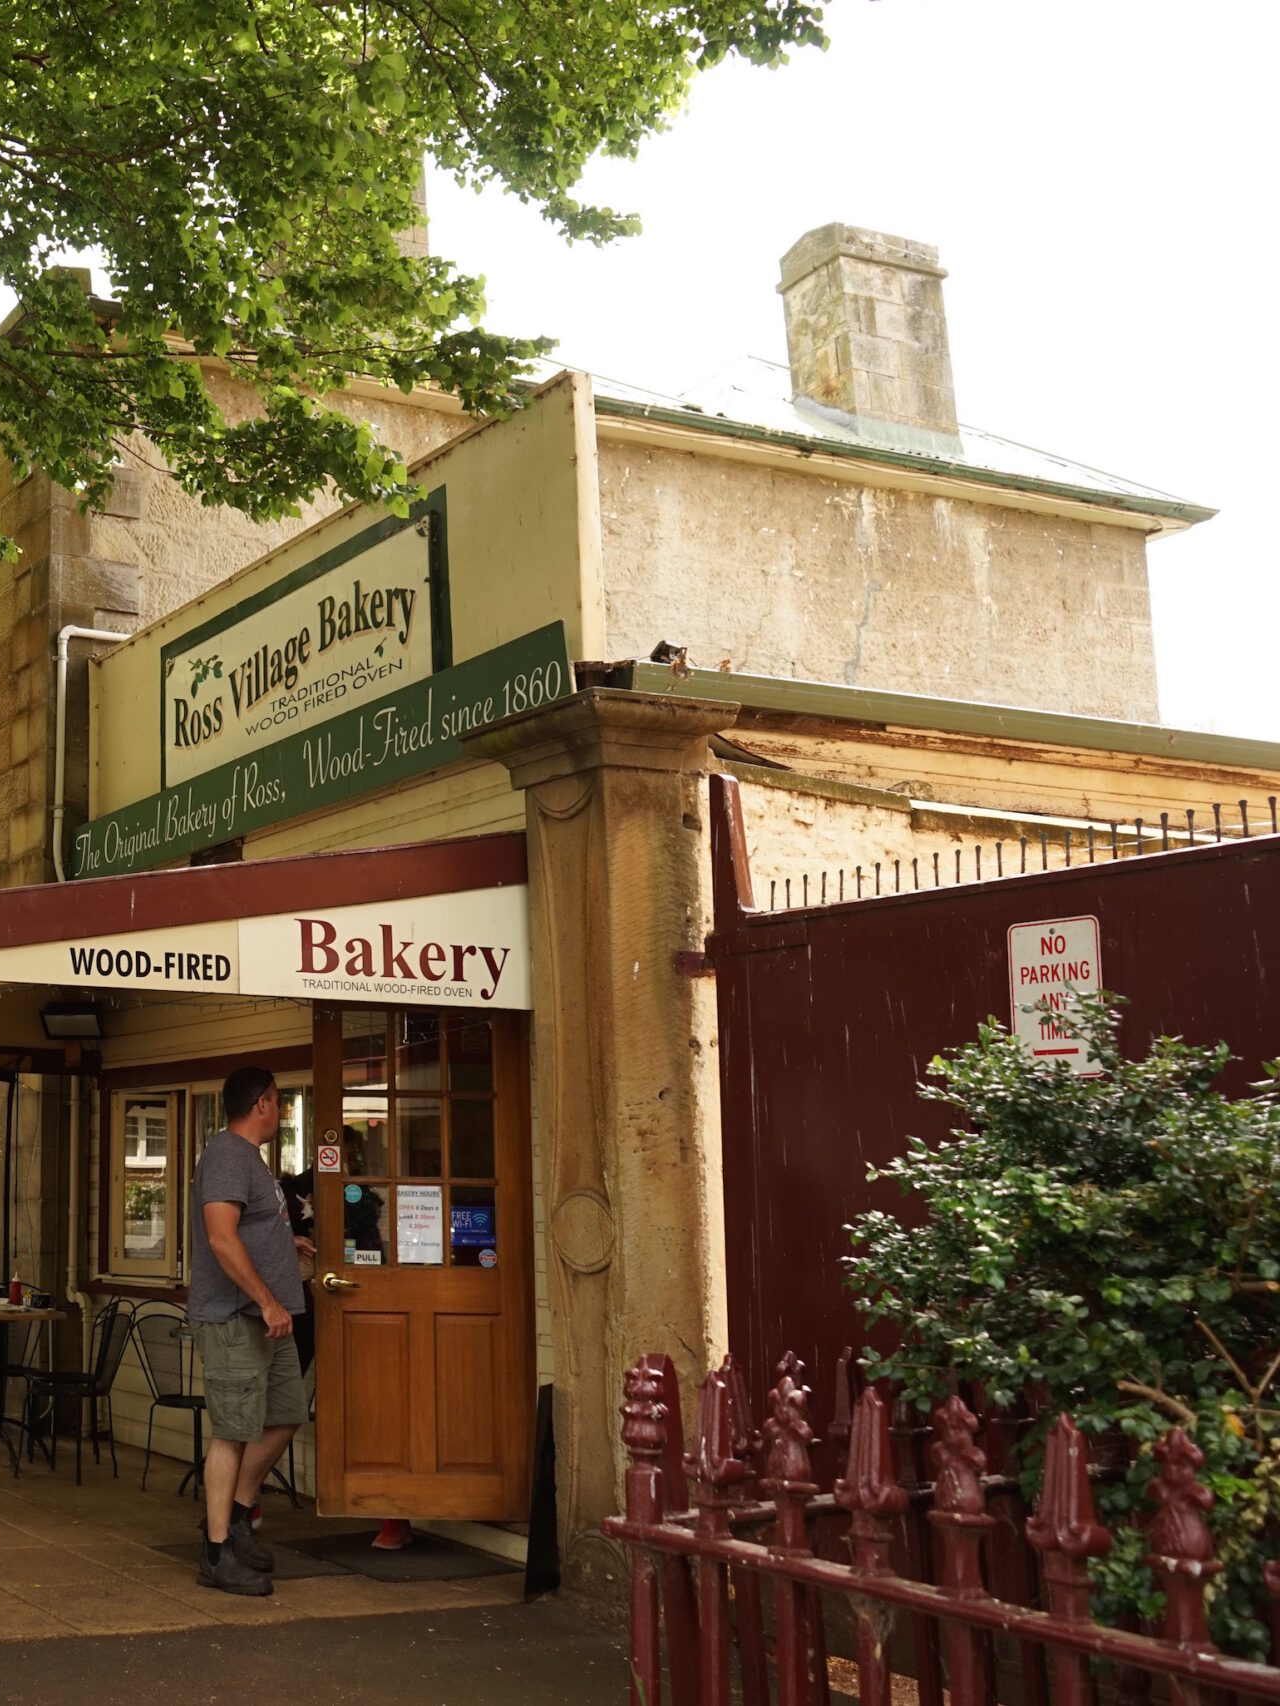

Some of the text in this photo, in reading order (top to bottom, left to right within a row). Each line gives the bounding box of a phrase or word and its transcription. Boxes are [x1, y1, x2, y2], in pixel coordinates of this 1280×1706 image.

[173, 579, 417, 748] Ross Village Bakery
[244, 657, 404, 738] WOOD FIRED OVEN
[269, 657, 375, 714] TRADITIONAL
[74, 659, 563, 877] The Original Bakery of Ross, Wood-Fired since 1860
[293, 917, 512, 1001] Bakery
[1040, 934, 1067, 956] NO
[69, 946, 232, 983] WOOD-FIRED
[1020, 960, 1090, 985] PARKING
[302, 978, 474, 998] TRADITIONAL WOOD-FIRED OVEN
[451, 1211, 472, 1221] FREE
[451, 1220, 472, 1229] WI-FI
[356, 1253, 378, 1262] PULL
